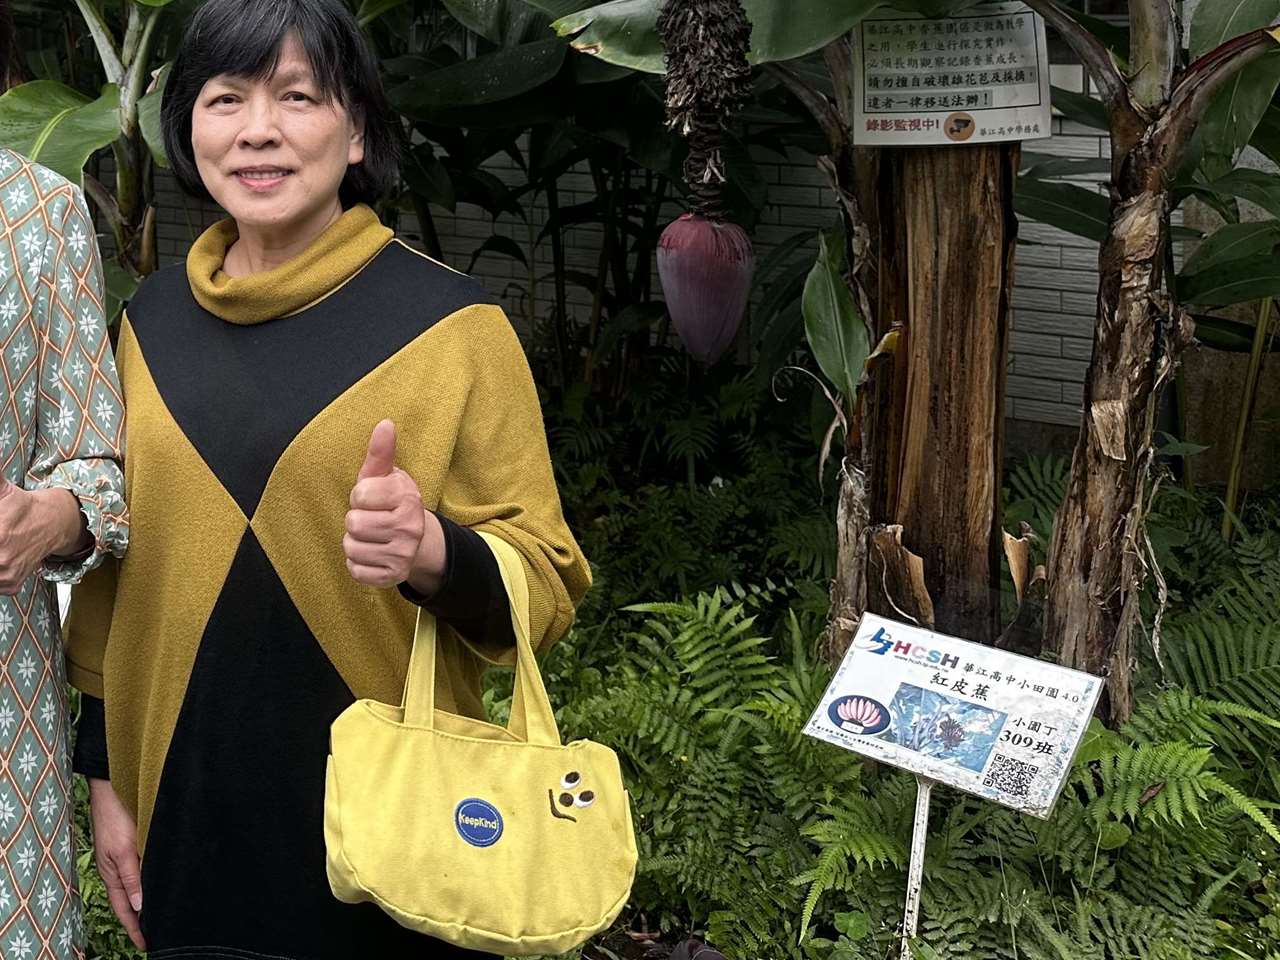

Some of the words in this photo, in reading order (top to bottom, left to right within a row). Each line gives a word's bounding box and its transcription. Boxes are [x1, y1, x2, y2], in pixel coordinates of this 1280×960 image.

[893, 640, 960, 669] HCSH
[929, 672, 991, 702] 紅皮蕉
[963, 662, 1060, 699] 華江高中小田園
[1012, 716, 1058, 736] 小園丁
[999, 730, 1055, 756] 309班
[459, 814, 497, 829] KeepKind
